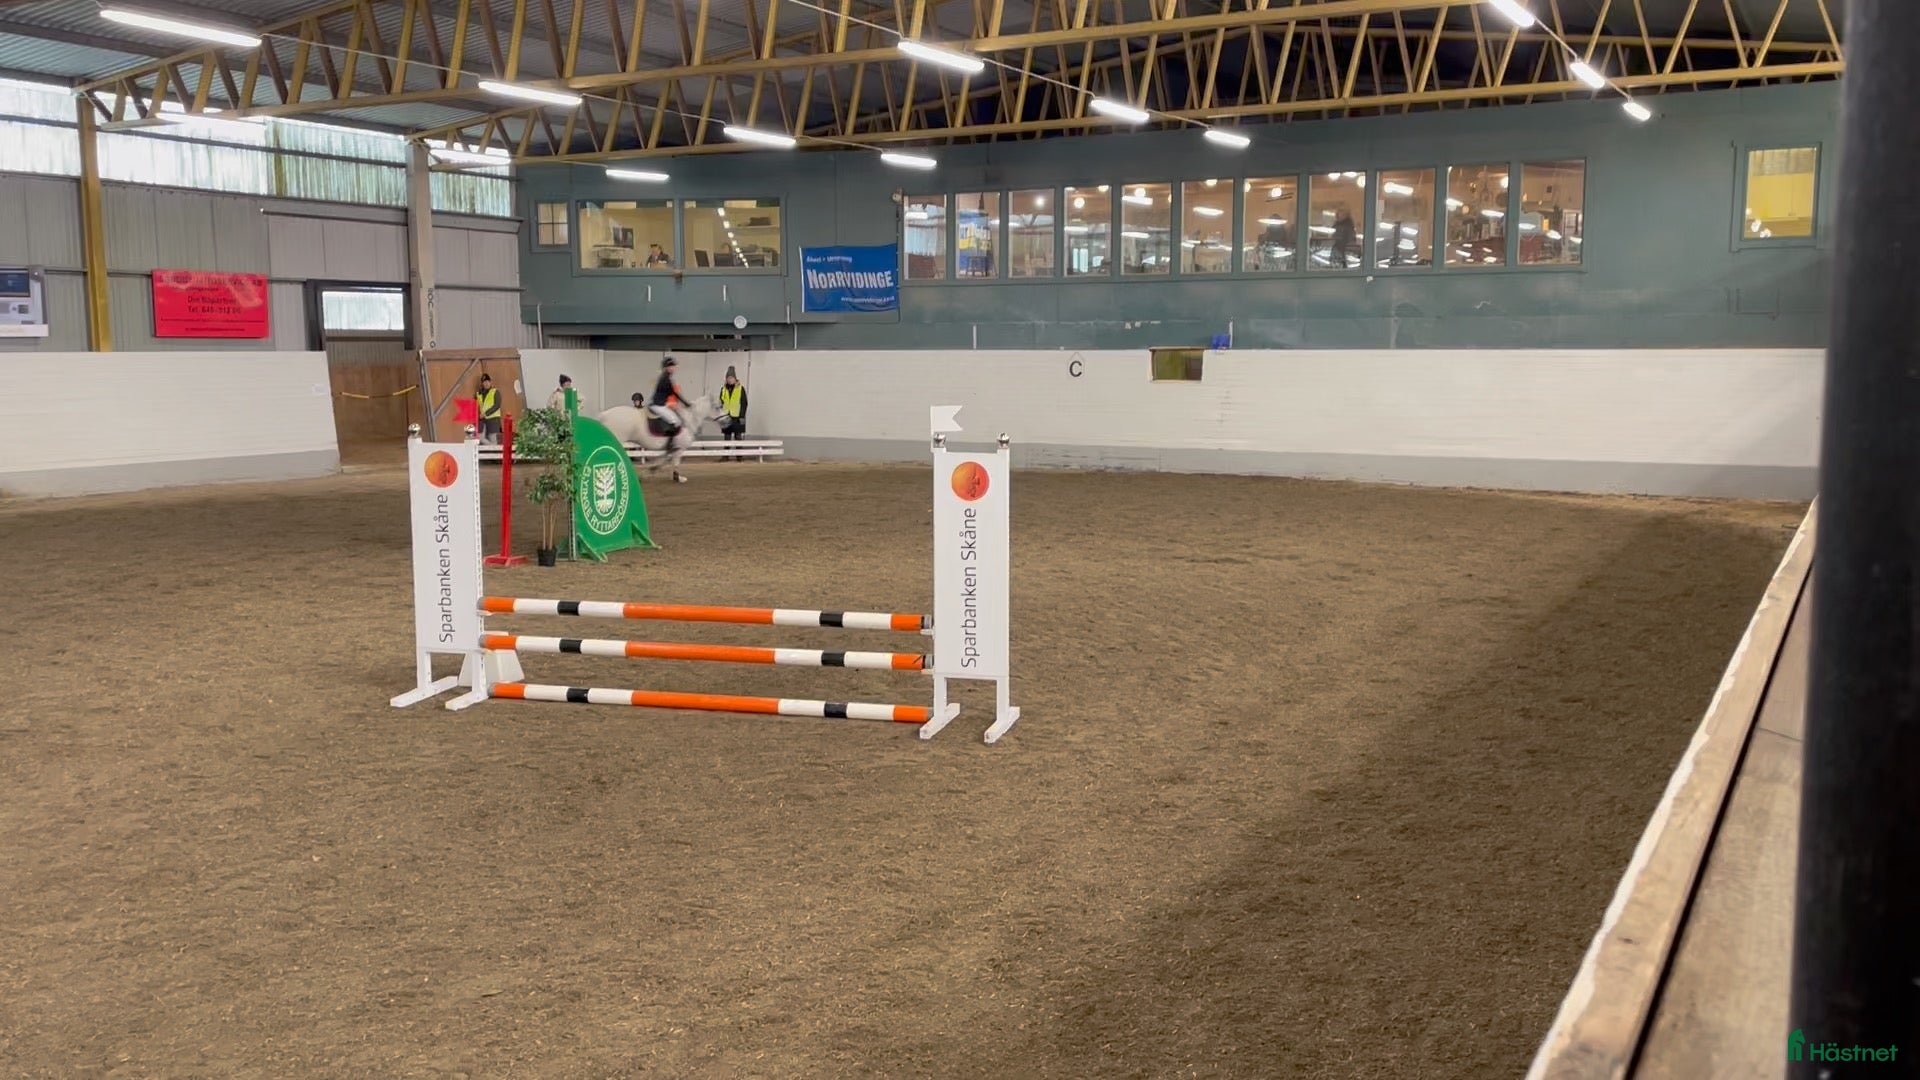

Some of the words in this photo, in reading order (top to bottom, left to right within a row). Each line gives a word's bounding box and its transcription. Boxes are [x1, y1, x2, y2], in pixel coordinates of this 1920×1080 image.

[806, 269, 894, 289] NORRVIDINGE
[1069, 360, 1083, 378] C
[433, 494, 450, 543] Skåne
[959, 508, 977, 561] Skåne
[437, 548, 455, 643] Sparbanken
[960, 566, 980, 668] Sparbanken
